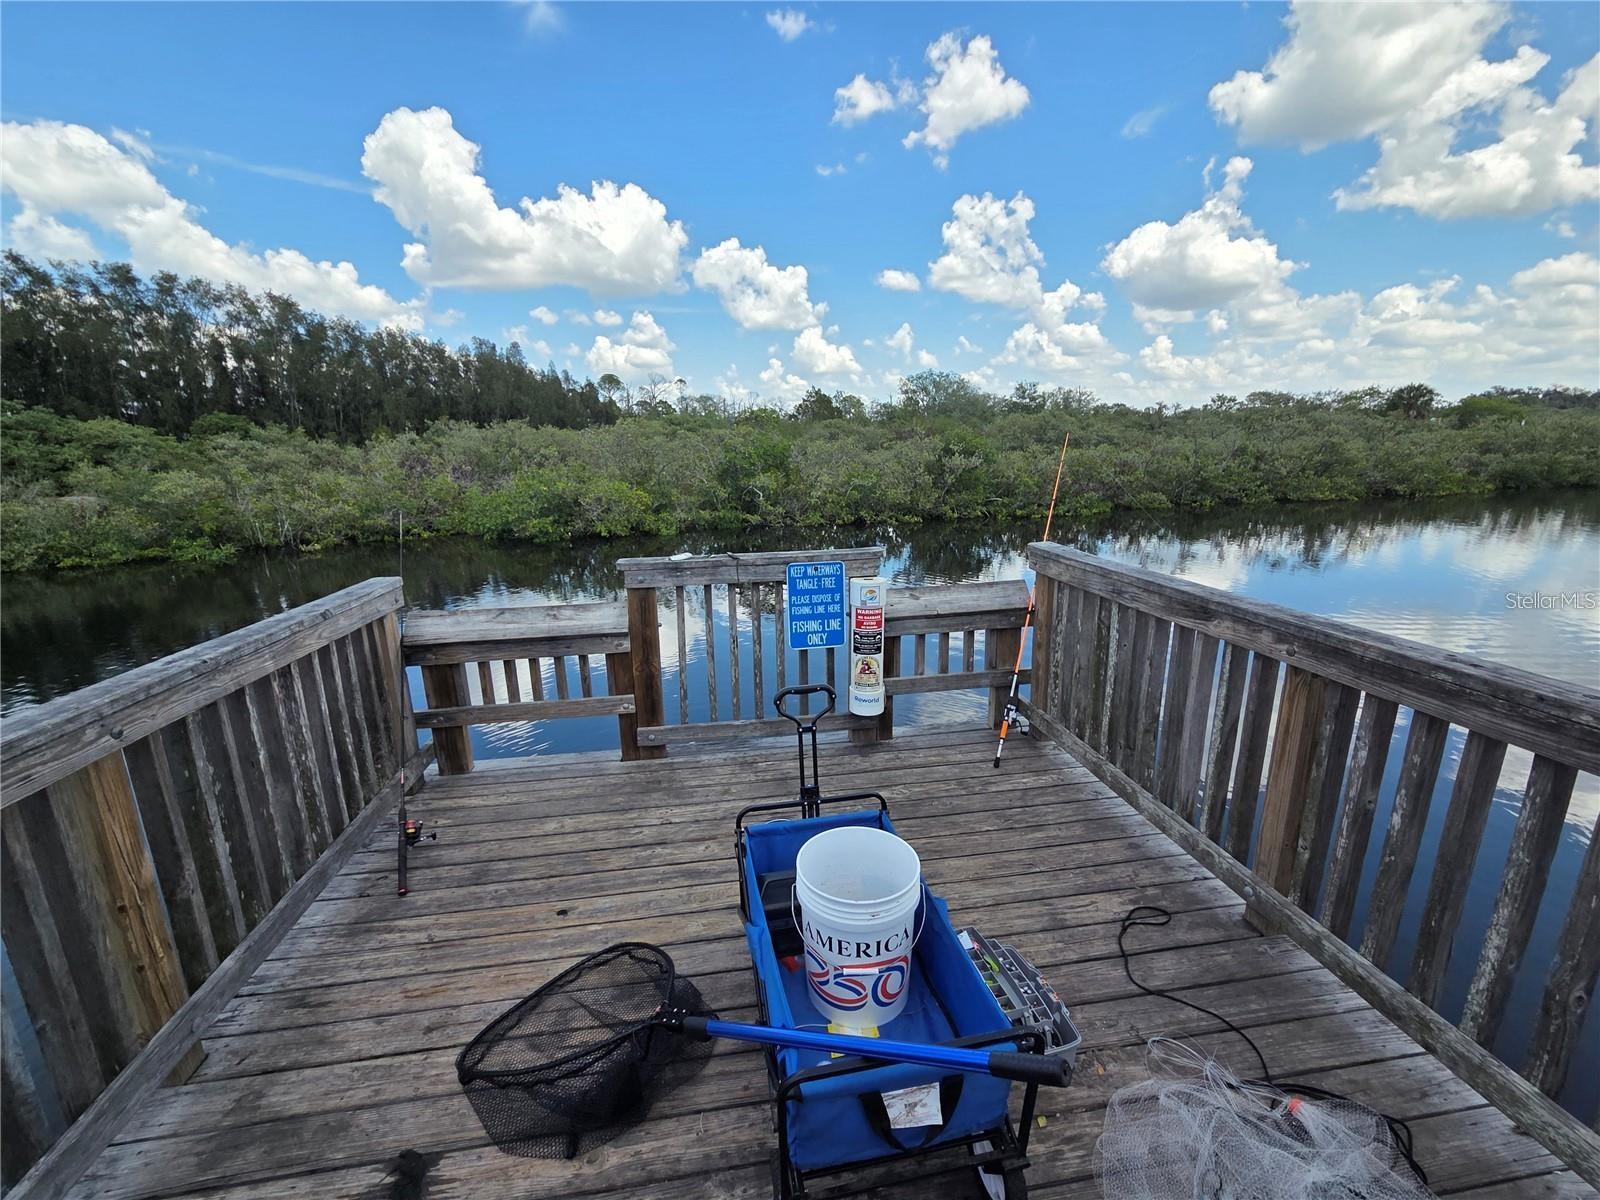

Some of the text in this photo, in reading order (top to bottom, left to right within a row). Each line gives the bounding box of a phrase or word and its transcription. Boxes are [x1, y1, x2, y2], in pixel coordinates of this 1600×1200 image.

[790, 566, 805, 577] KEEP
[791, 593, 841, 605] PLEASE DISPOSE OF
[791, 604, 841, 615] FISHING LINE HERE
[792, 619, 842, 633] FISHING LINE
[807, 633, 828, 646] ONLY
[805, 921, 910, 958] AMERICA
